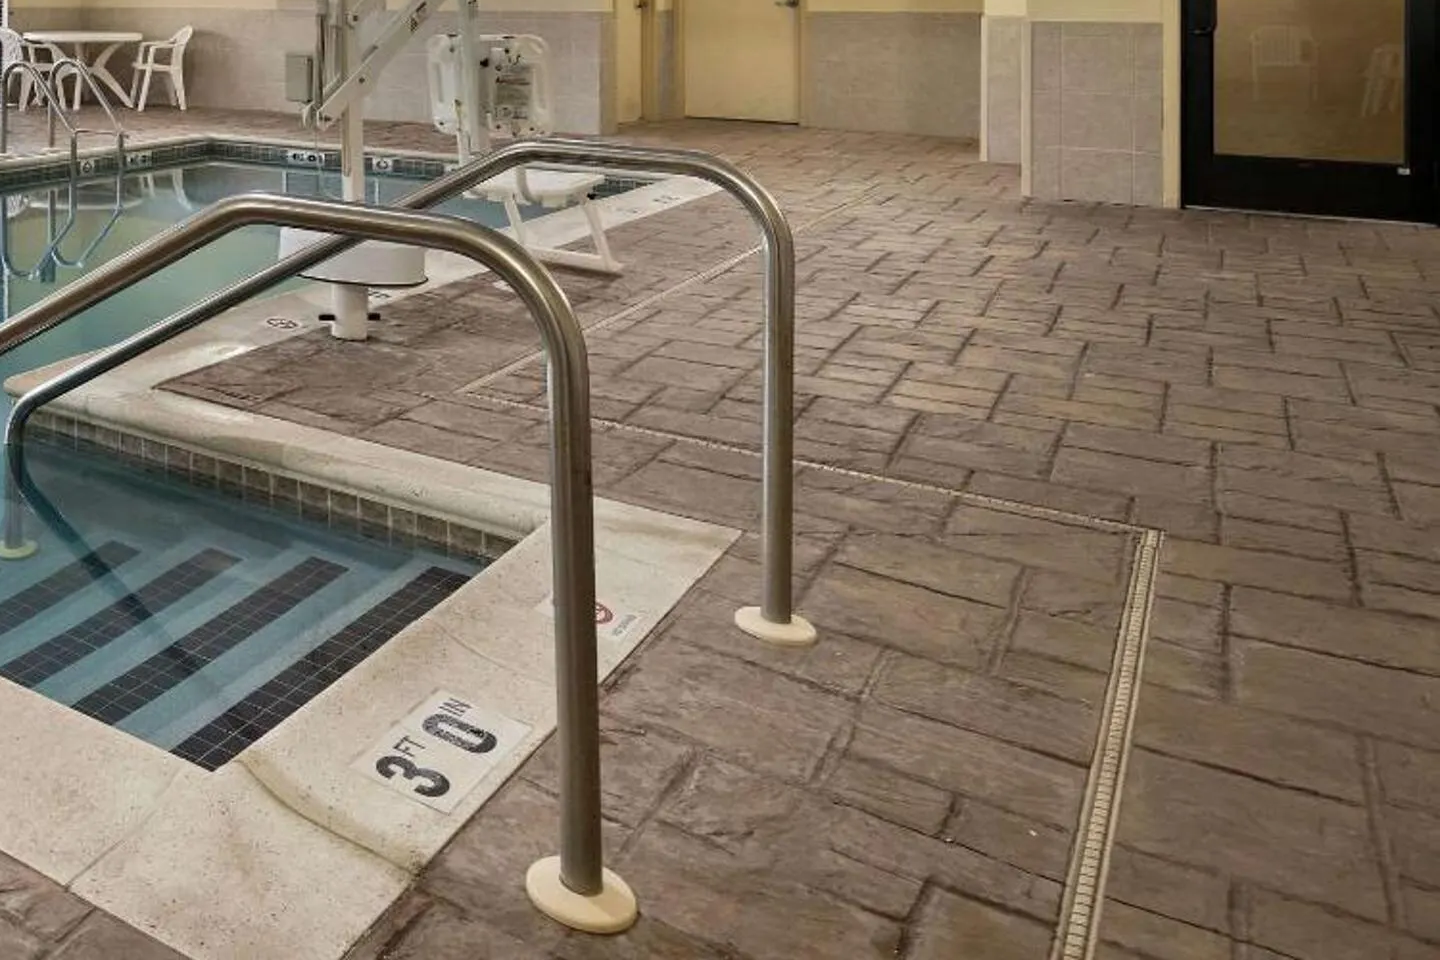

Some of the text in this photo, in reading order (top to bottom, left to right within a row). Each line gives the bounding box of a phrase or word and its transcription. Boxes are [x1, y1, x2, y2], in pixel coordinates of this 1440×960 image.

[376, 698, 498, 797] 3 FT 0 IN
